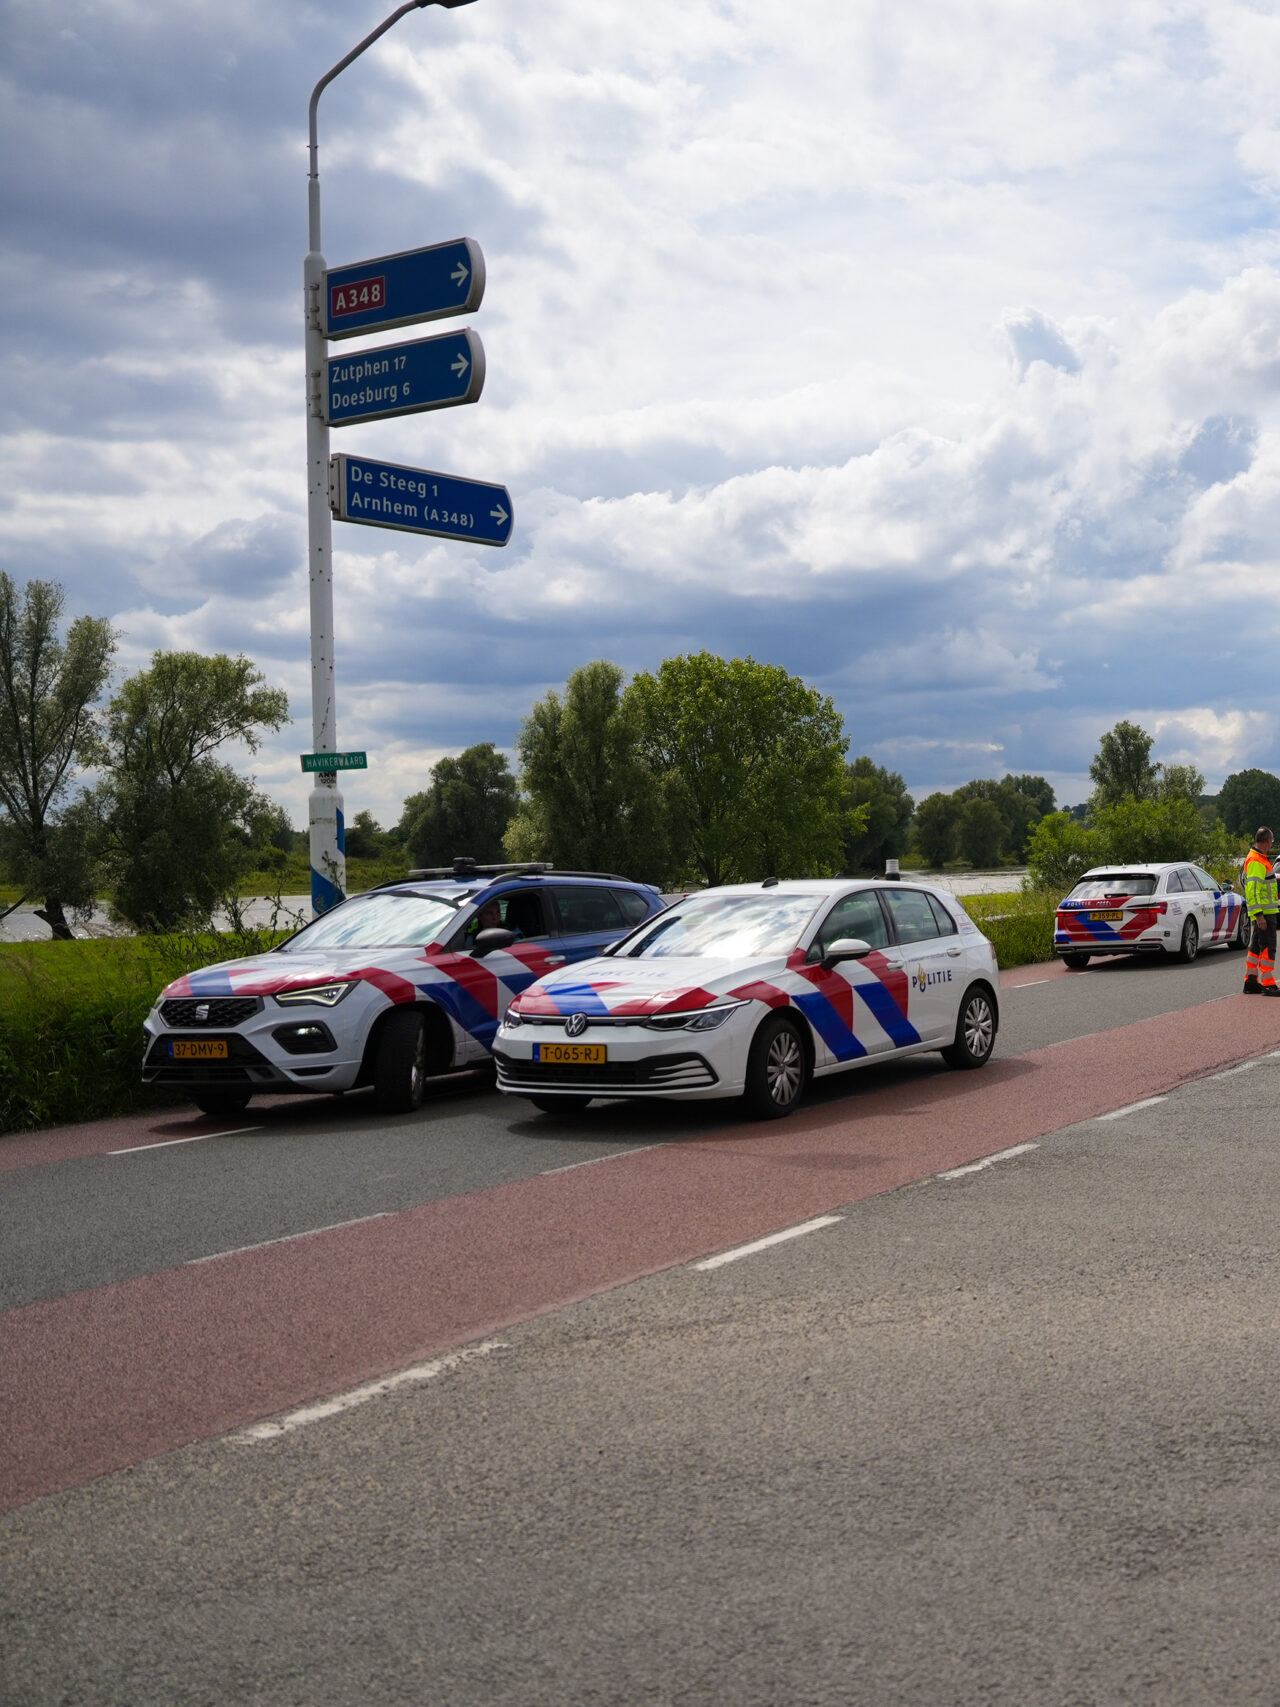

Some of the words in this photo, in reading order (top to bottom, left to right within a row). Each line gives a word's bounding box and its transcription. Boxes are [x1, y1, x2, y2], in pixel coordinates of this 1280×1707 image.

[335, 284, 381, 311] A348
[332, 358, 389, 383] Zutphen
[393, 356, 407, 370] 17
[332, 384, 397, 409] Doesburg
[402, 382, 410, 396] 6
[351, 465, 373, 484] De
[379, 471, 427, 498] Steeg
[431, 485, 438, 497] 1
[351, 492, 418, 518] Arnhem
[424, 505, 475, 528] (A348)
[307, 756, 364, 769] HAVIKERWAARD
[911, 969, 953, 993] POLITIE
[175, 1043, 225, 1056] 37-DMV-9
[543, 1046, 600, 1061] T-065-RJ
